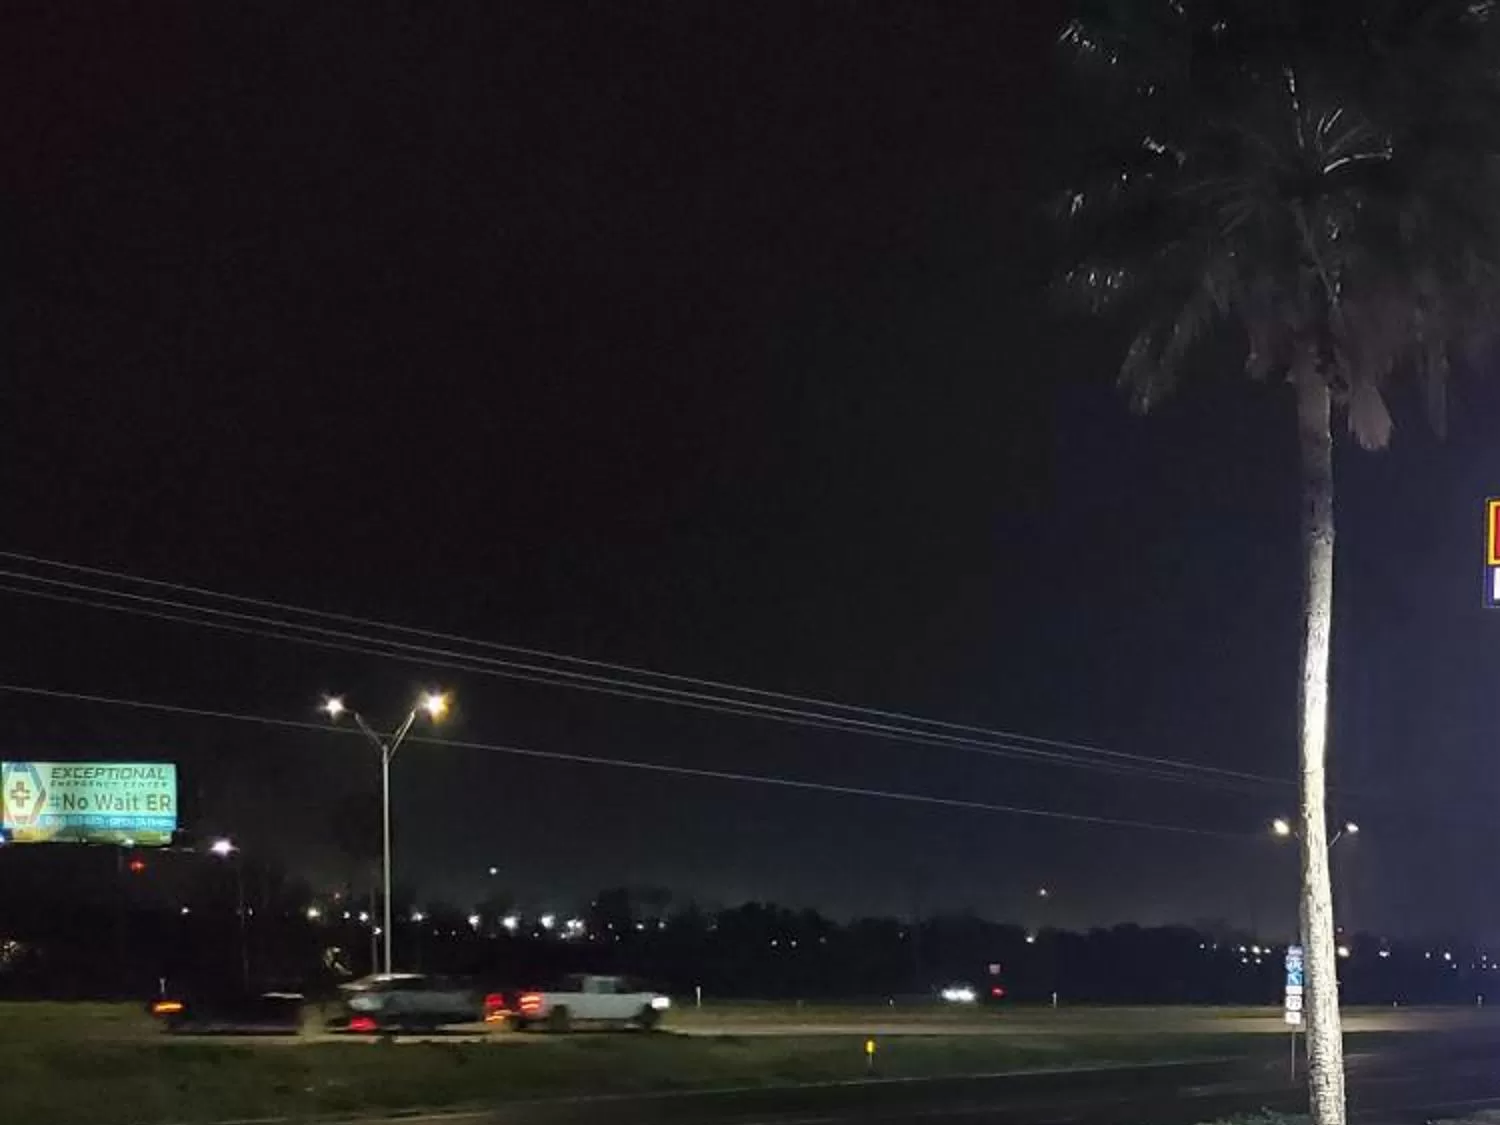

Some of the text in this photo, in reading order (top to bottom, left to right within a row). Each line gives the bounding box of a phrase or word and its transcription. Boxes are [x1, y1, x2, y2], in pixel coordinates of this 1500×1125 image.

[51, 767, 166, 780] EXCEPTIONAL
[95, 790, 138, 811] Wait
[146, 792, 172, 812] ER
